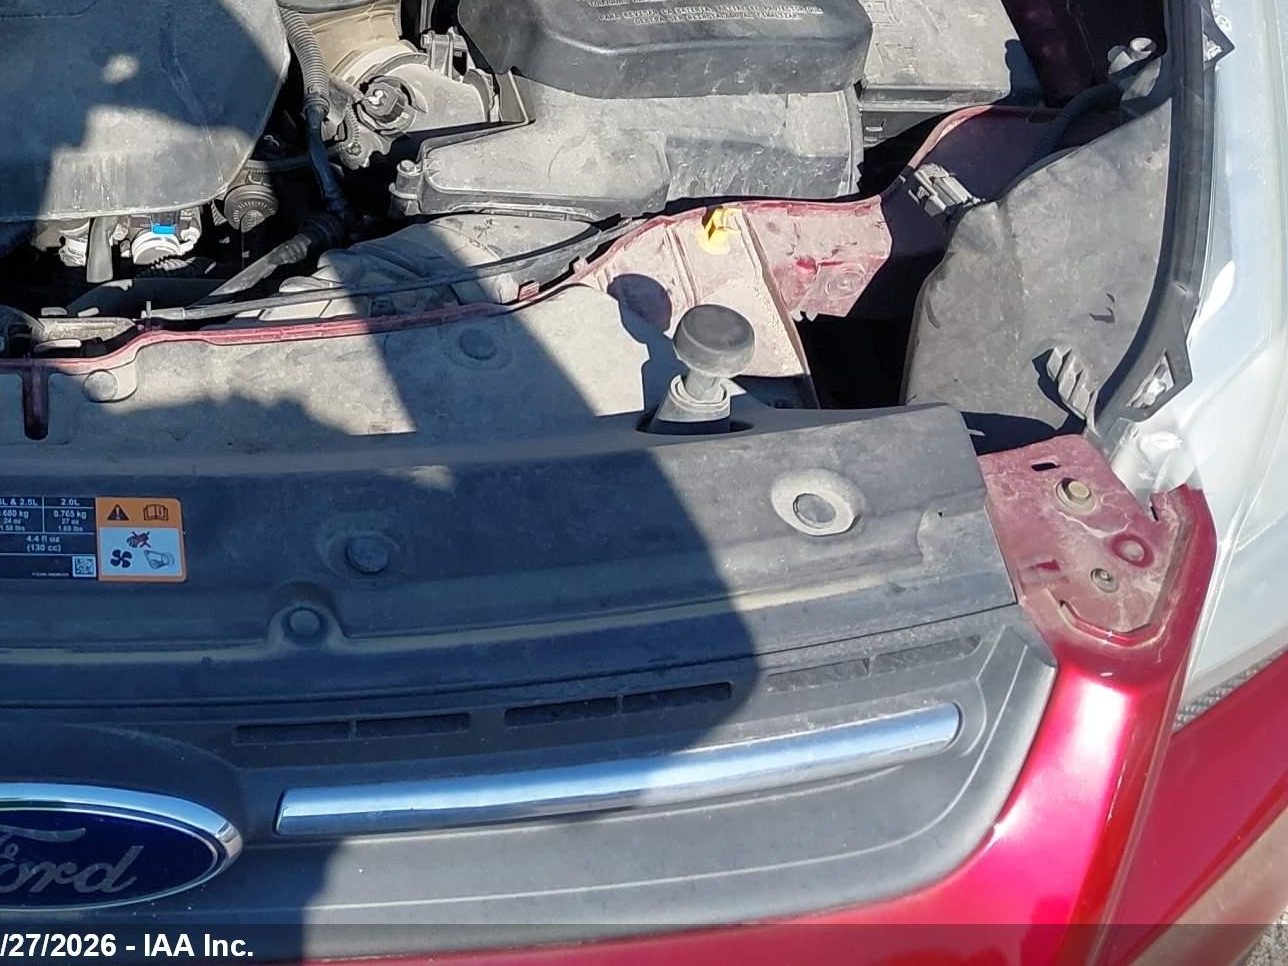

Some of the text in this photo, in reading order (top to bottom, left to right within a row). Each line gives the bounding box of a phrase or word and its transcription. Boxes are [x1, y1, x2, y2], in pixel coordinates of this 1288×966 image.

[10, 498, 17, 506] &
[60, 498, 80, 506] 2.0L
[18, 510, 29, 519] kg
[76, 510, 87, 519] kg
[27, 544, 61, 552] (130 cc)
